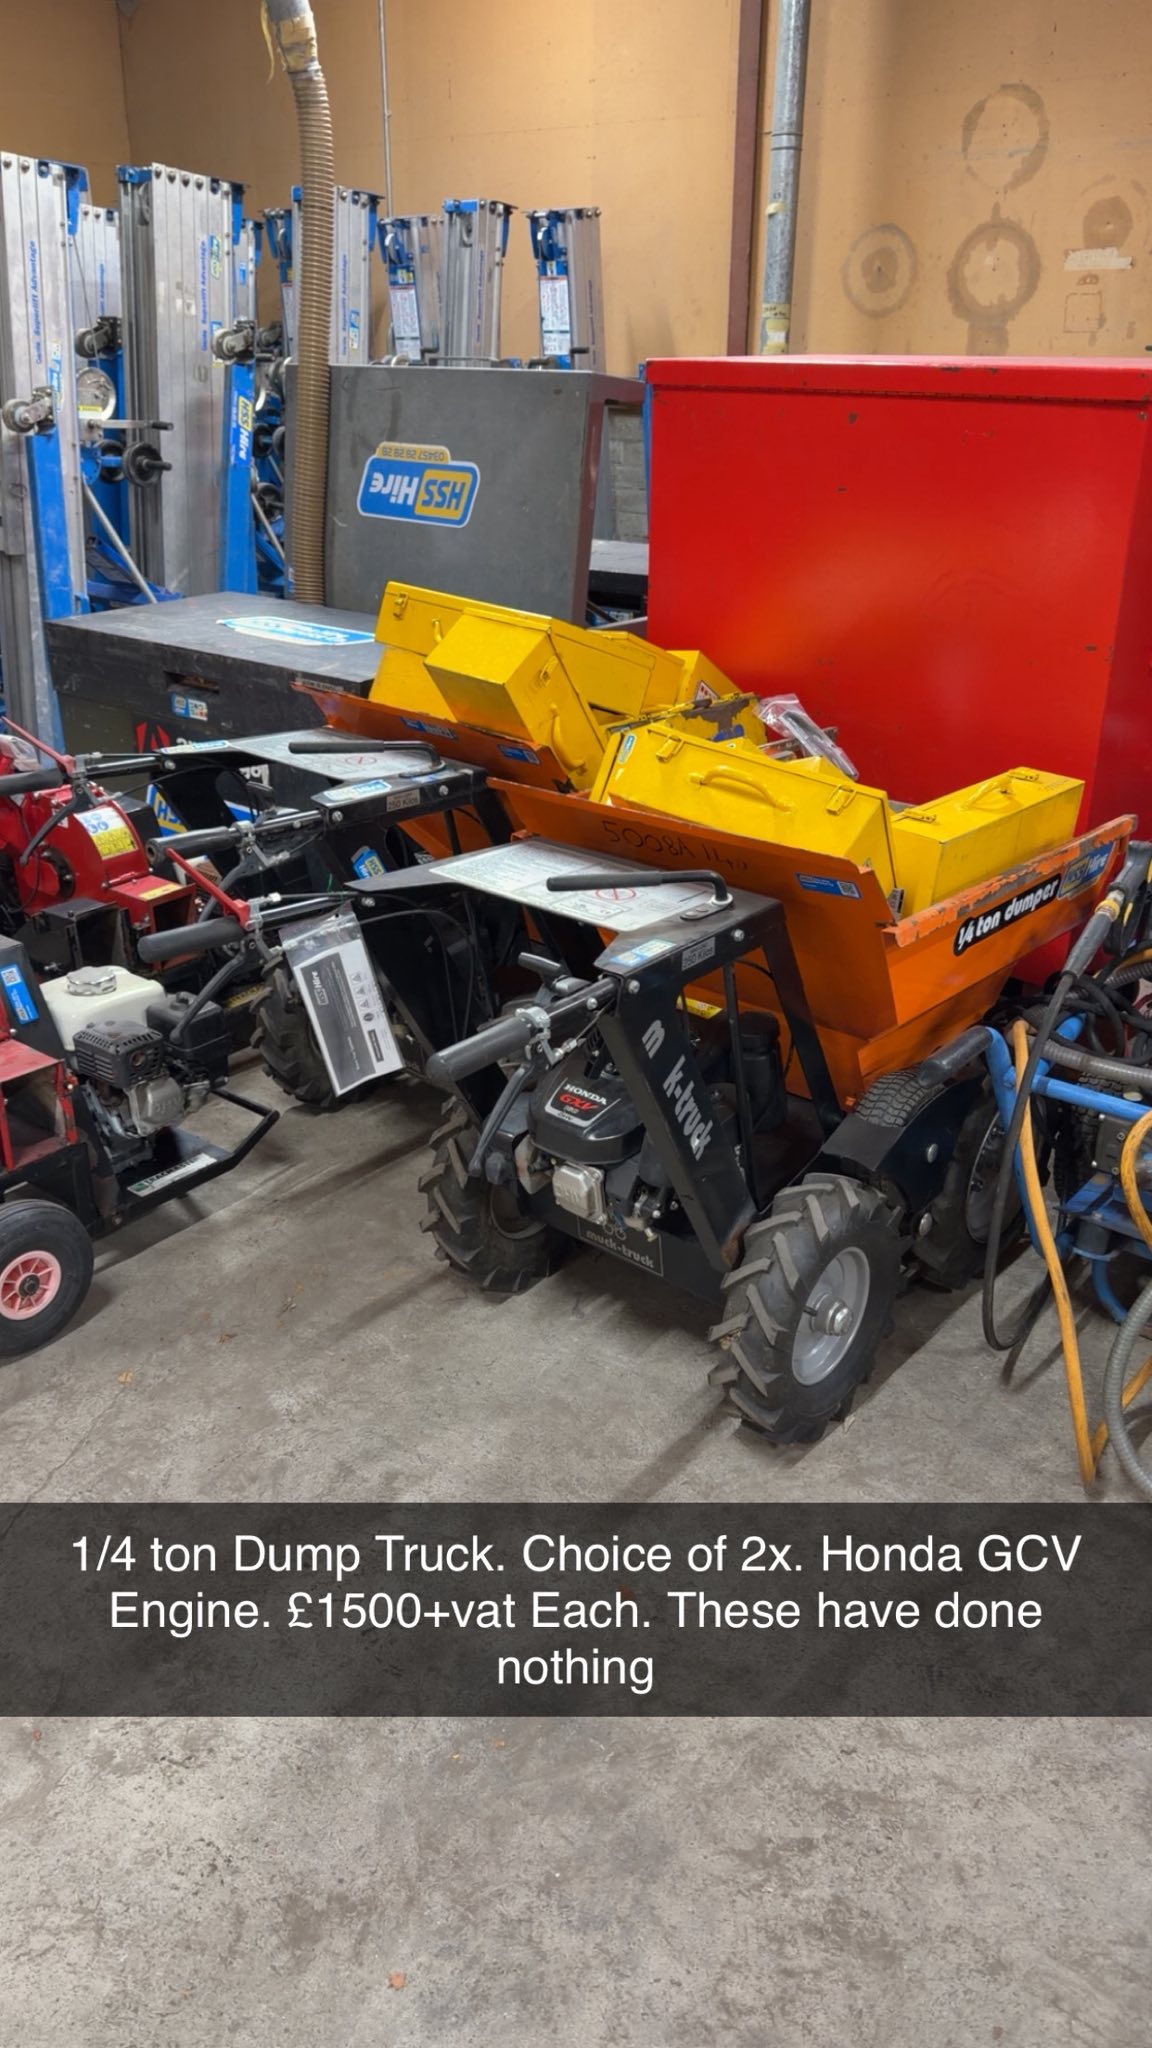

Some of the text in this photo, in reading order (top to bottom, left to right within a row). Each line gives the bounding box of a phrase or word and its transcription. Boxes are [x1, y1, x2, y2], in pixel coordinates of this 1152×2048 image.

[29, 240, 38, 292] Advantage
[32, 291, 41, 337] Superlift
[239, 402, 250, 461] HSS Hire
[368, 471, 467, 512] HSS Hire
[601, 819, 697, 859] 5008A
[1088, 853, 1110, 875] Hire
[975, 910, 1002, 938] ton
[1003, 878, 1060, 922] dumper
[311, 971, 322, 989] Hire
[559, 1093, 600, 1110] GXV
[563, 1084, 607, 1106] HONDA
[586, 1229, 655, 1269] muck-truck
